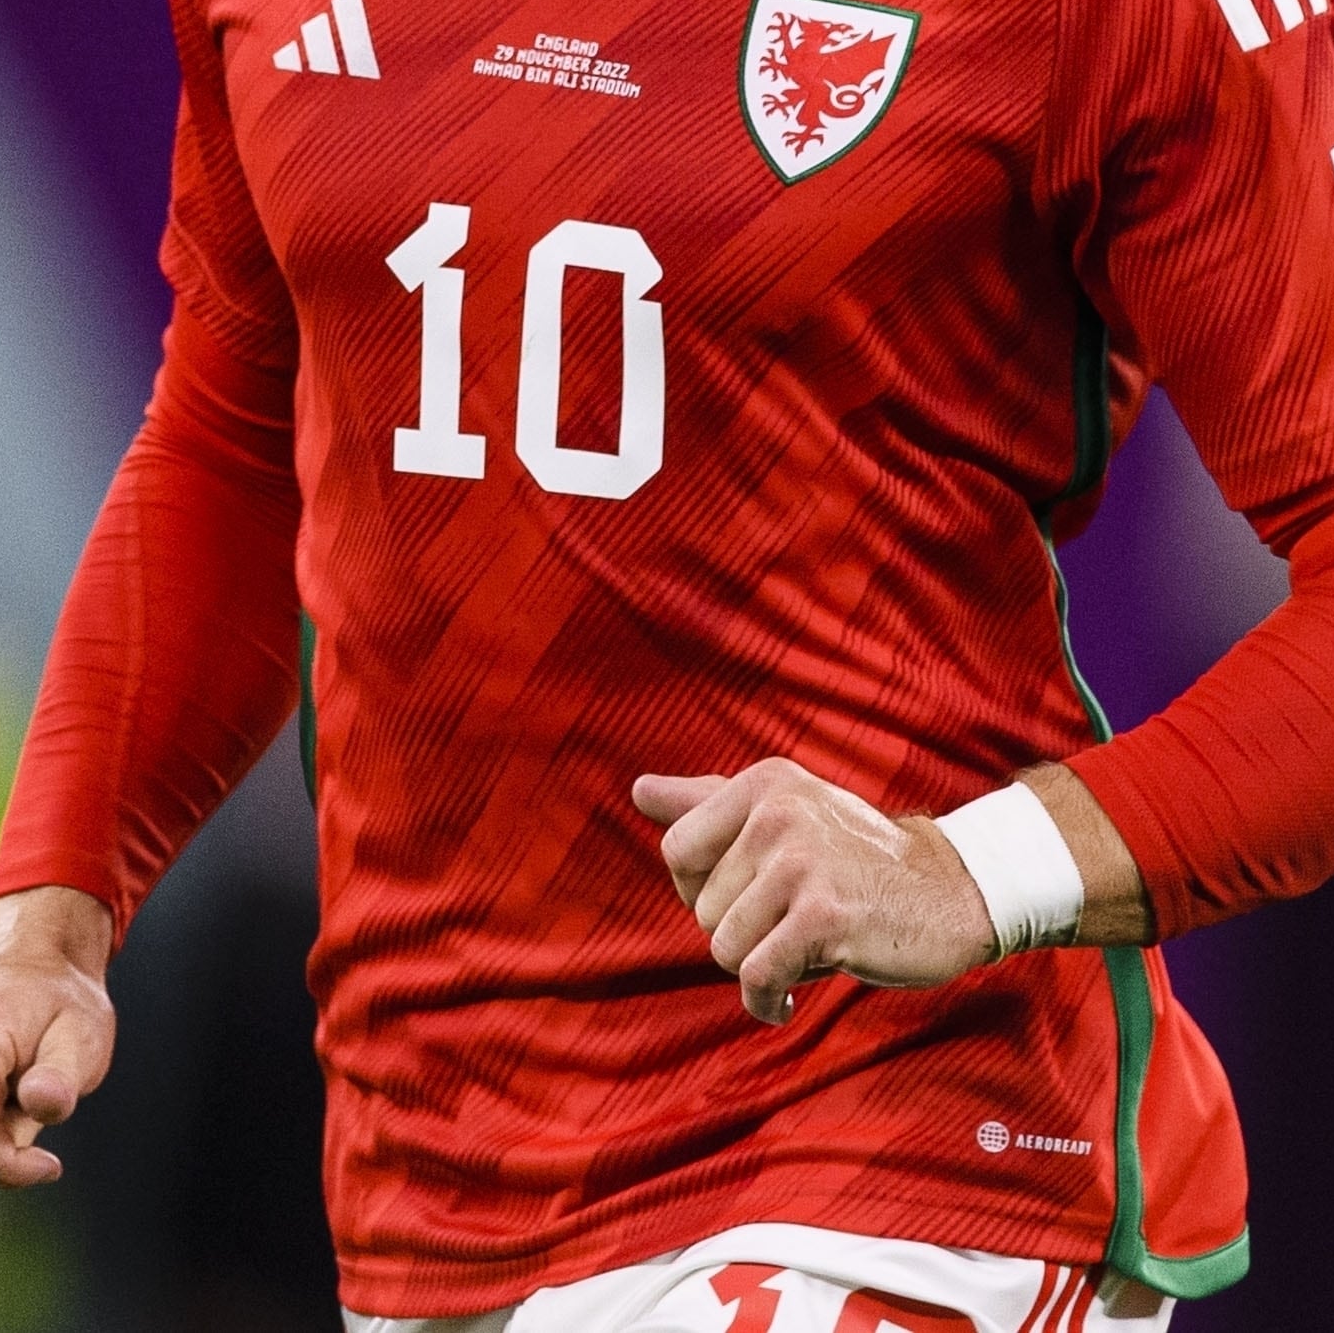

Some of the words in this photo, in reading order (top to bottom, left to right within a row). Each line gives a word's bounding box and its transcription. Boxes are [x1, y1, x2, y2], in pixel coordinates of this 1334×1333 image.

[494, 44, 514, 61] 29
[516, 49, 591, 72] NOVEMBER
[592, 60, 630, 79] 2022
[534, 33, 599, 57] ENGLAND
[473, 58, 524, 80] AHMAD
[525, 67, 552, 84] BIN
[553, 71, 579, 88] ALI
[580, 75, 641, 98] STADIUM
[384, 201, 666, 501] 10
[1015, 1134, 1093, 1156] AEROREADY
